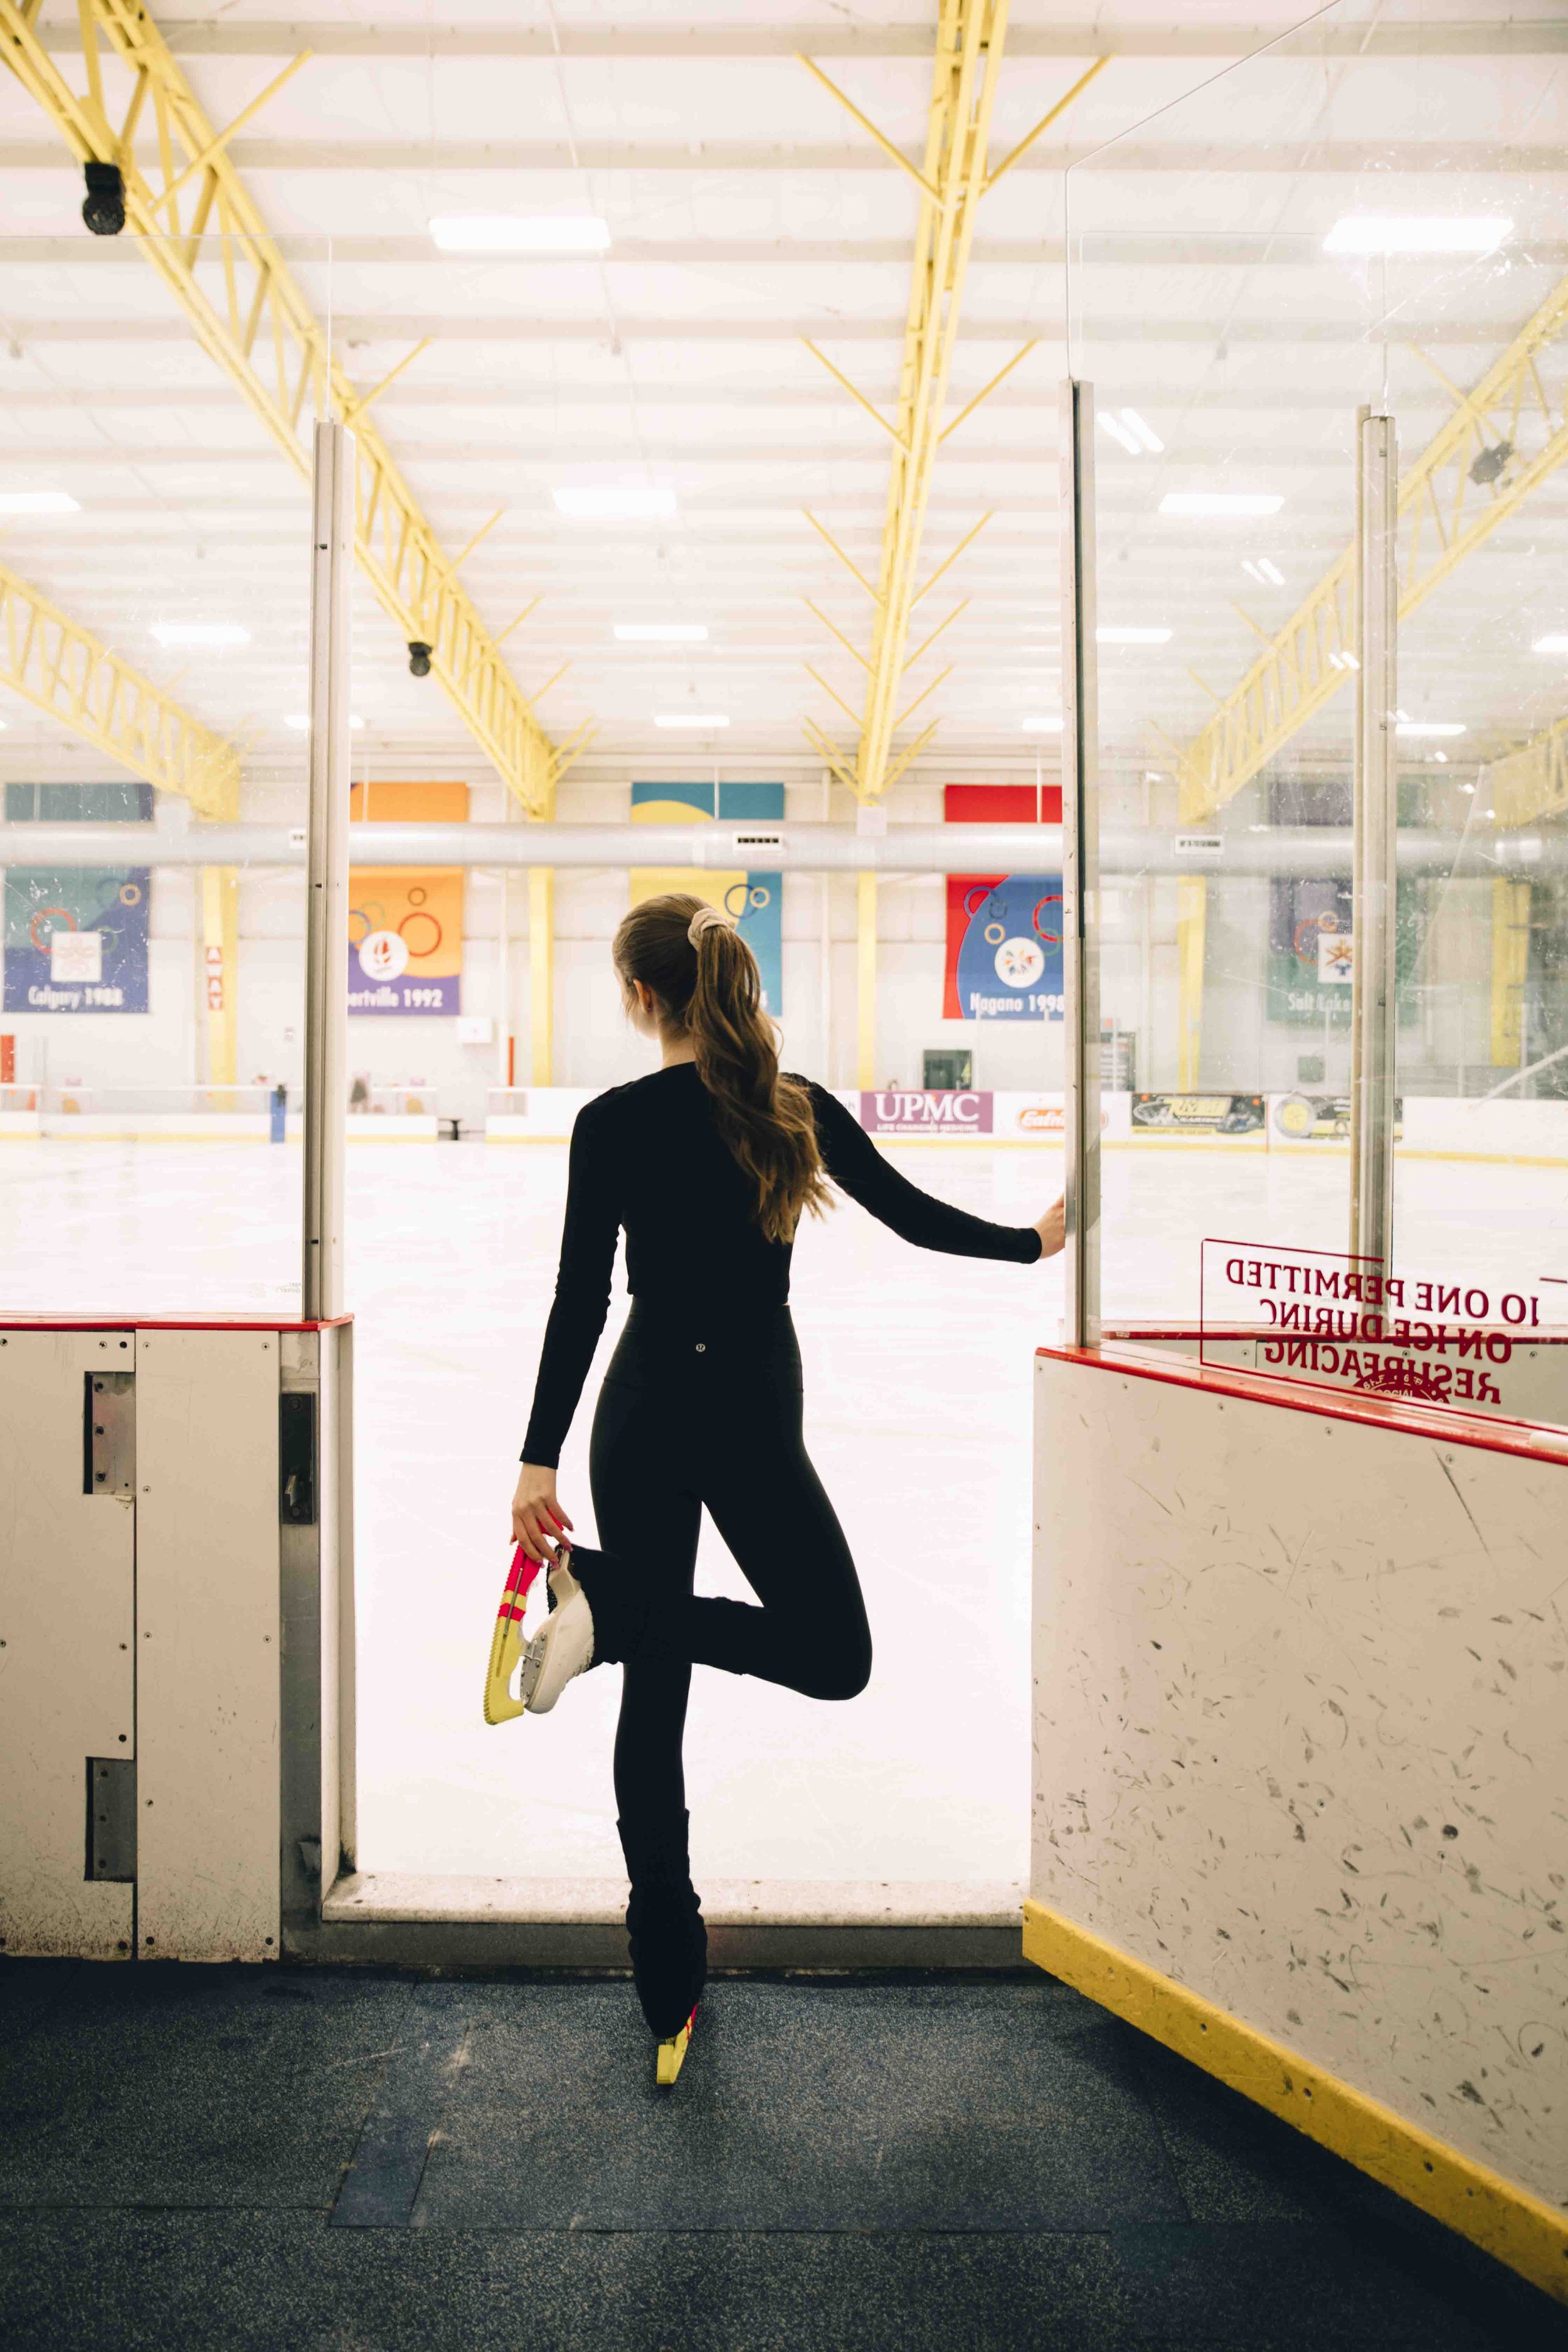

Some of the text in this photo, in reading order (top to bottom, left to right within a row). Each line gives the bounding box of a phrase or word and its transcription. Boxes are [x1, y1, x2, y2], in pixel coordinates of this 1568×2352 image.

[28, 985, 80, 1010] Calgary
[403, 988, 443, 1007] 1992
[970, 993, 1064, 1015] Nagano 1998
[1288, 992, 1351, 1012] Salt Lake
[875, 1093, 980, 1122] UPMC
